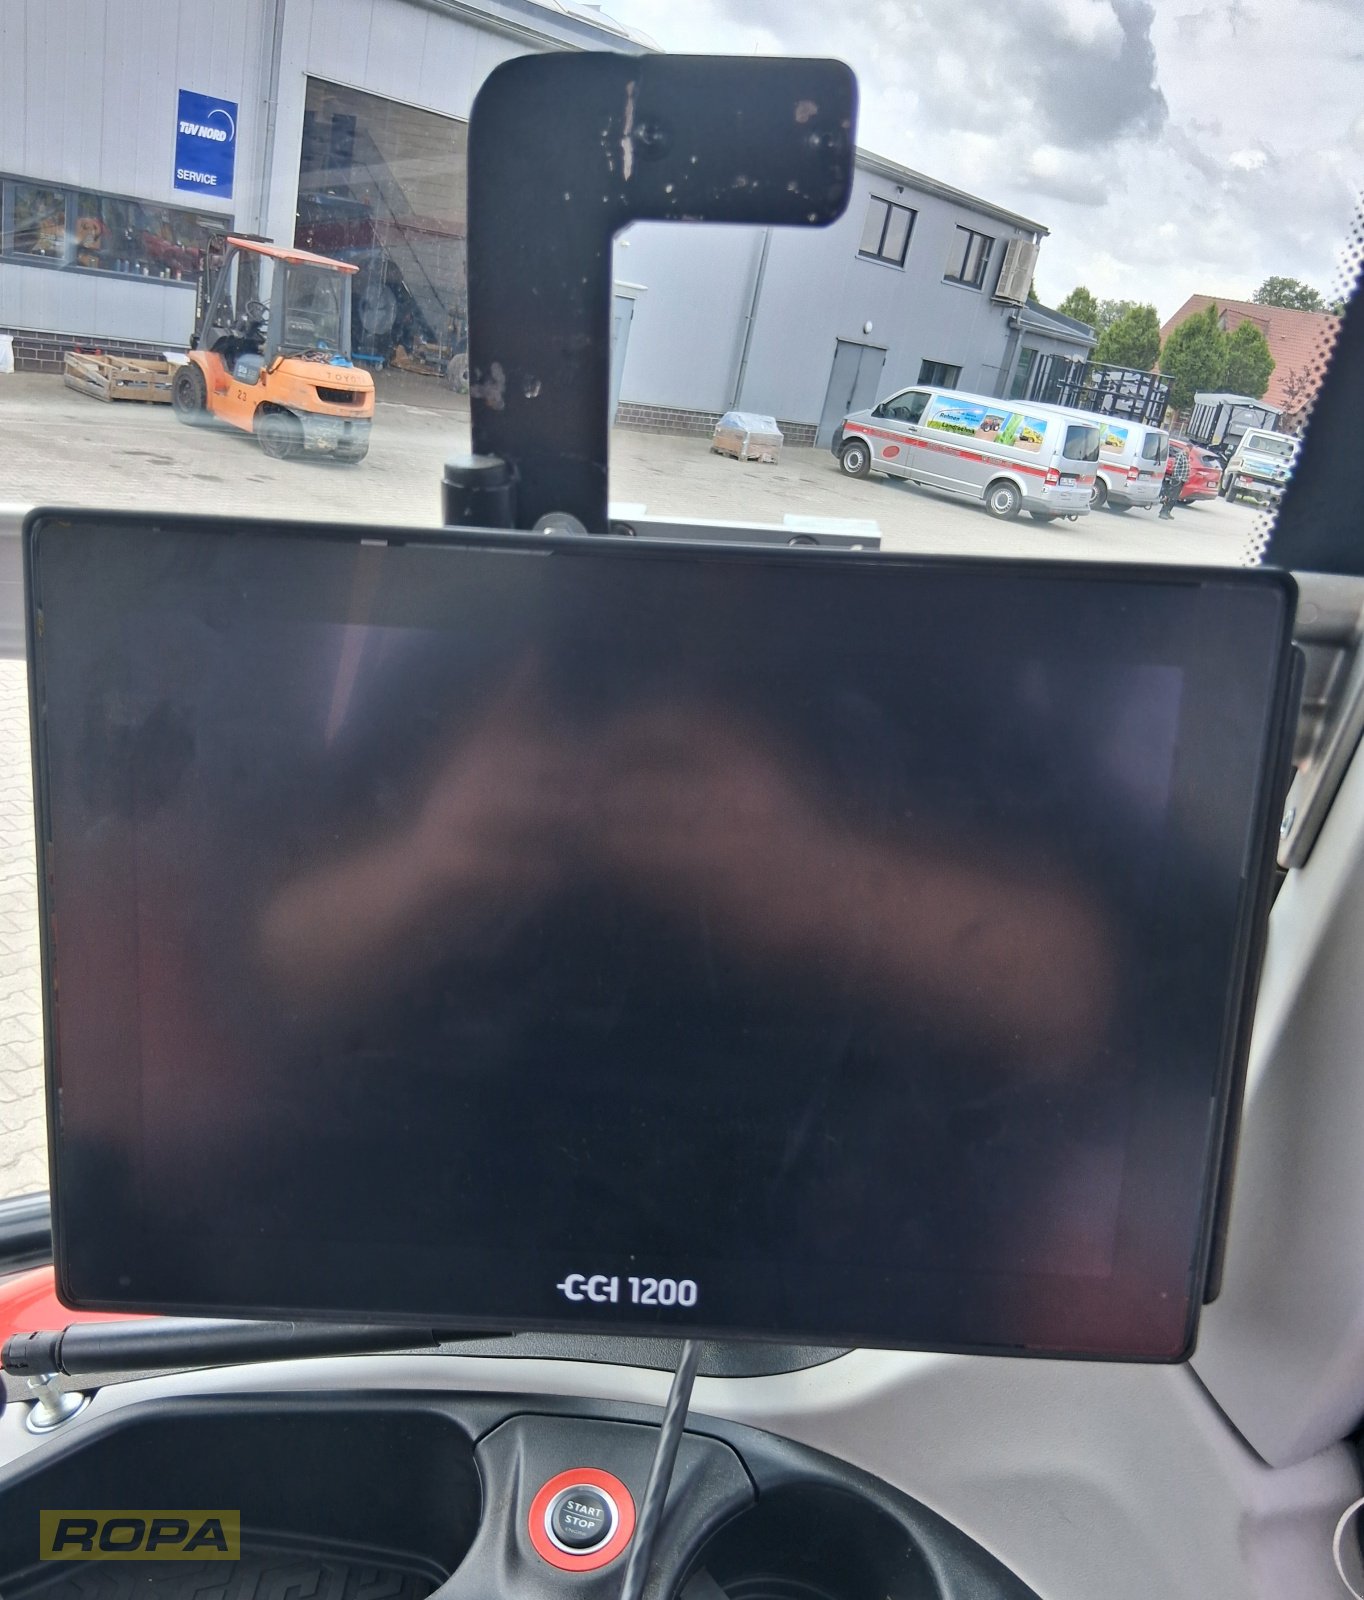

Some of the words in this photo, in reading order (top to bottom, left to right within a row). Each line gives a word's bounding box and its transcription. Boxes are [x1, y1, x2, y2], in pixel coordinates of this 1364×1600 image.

[180, 121, 199, 136] TÜV
[198, 125, 227, 142] NORD
[177, 168, 217, 186] SERVICE
[326, 371, 367, 384] TOYO
[237, 389, 248, 402] 23
[628, 1276, 698, 1307] 1200
[566, 1500, 603, 1517] START
[564, 1514, 596, 1529] STOP
